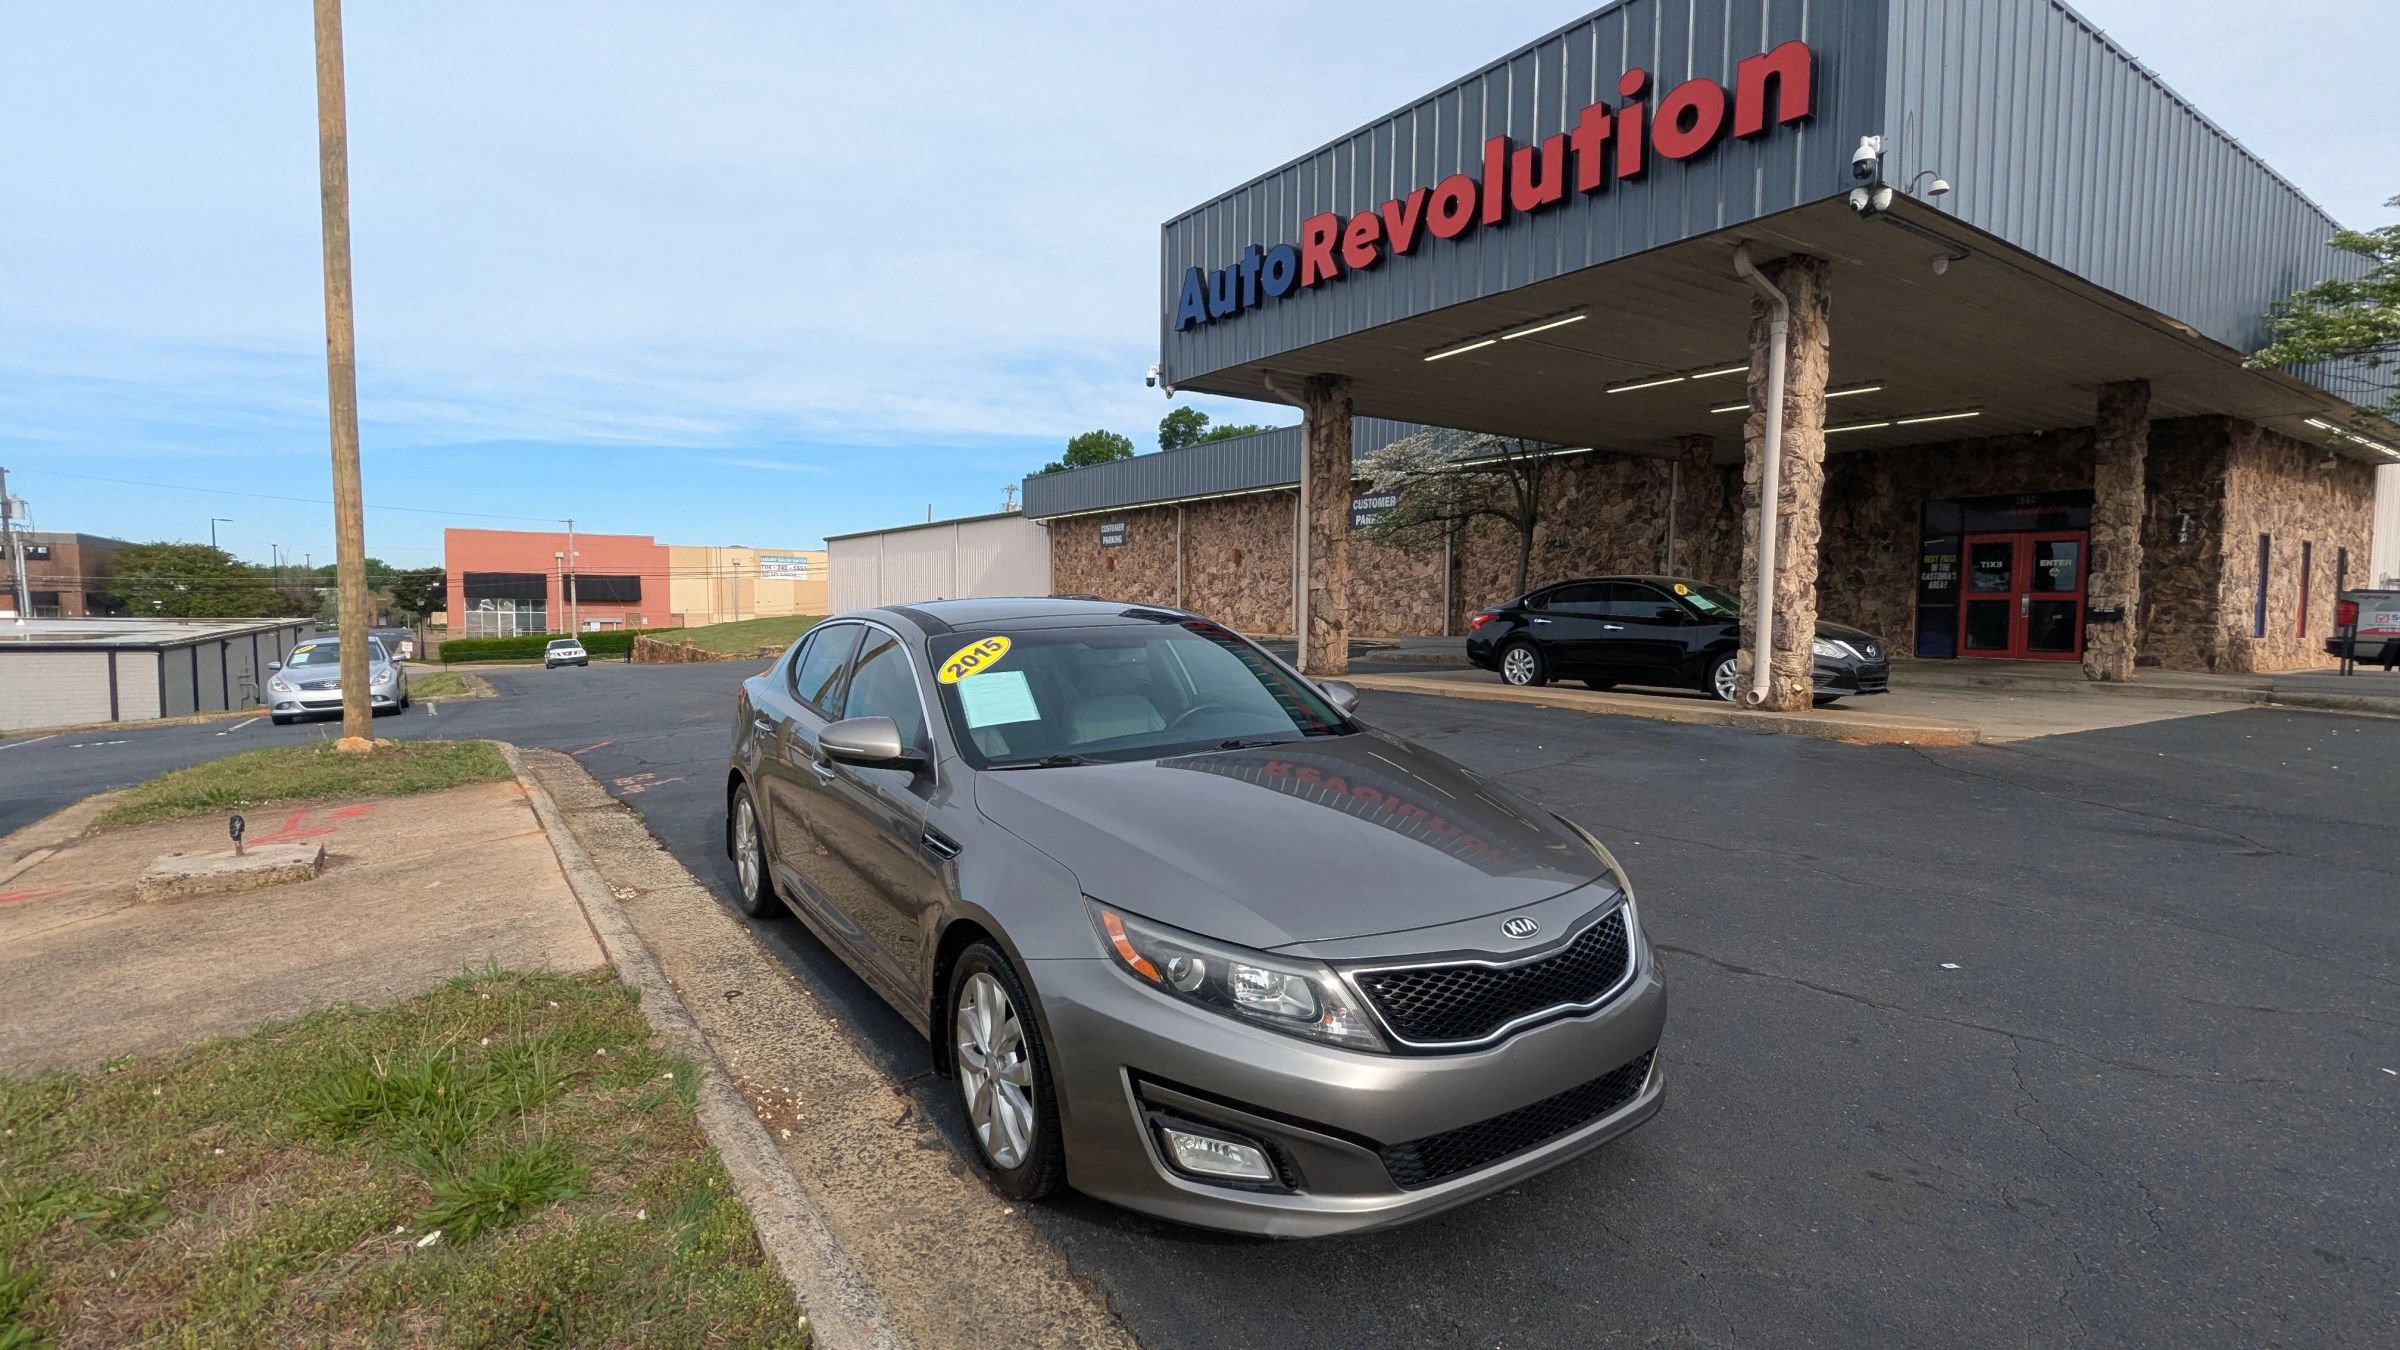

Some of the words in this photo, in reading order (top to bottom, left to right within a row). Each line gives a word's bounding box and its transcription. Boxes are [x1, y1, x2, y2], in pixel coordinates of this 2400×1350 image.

[1353, 496, 1397, 510] CUSTOMER
[1101, 523, 1125, 533] CUSTOMER
[1102, 535, 1123, 544] PARKING
[2039, 559, 2072, 567] ENTER
[947, 639, 1003, 678] 2015
[1505, 918, 1538, 935] KIA
